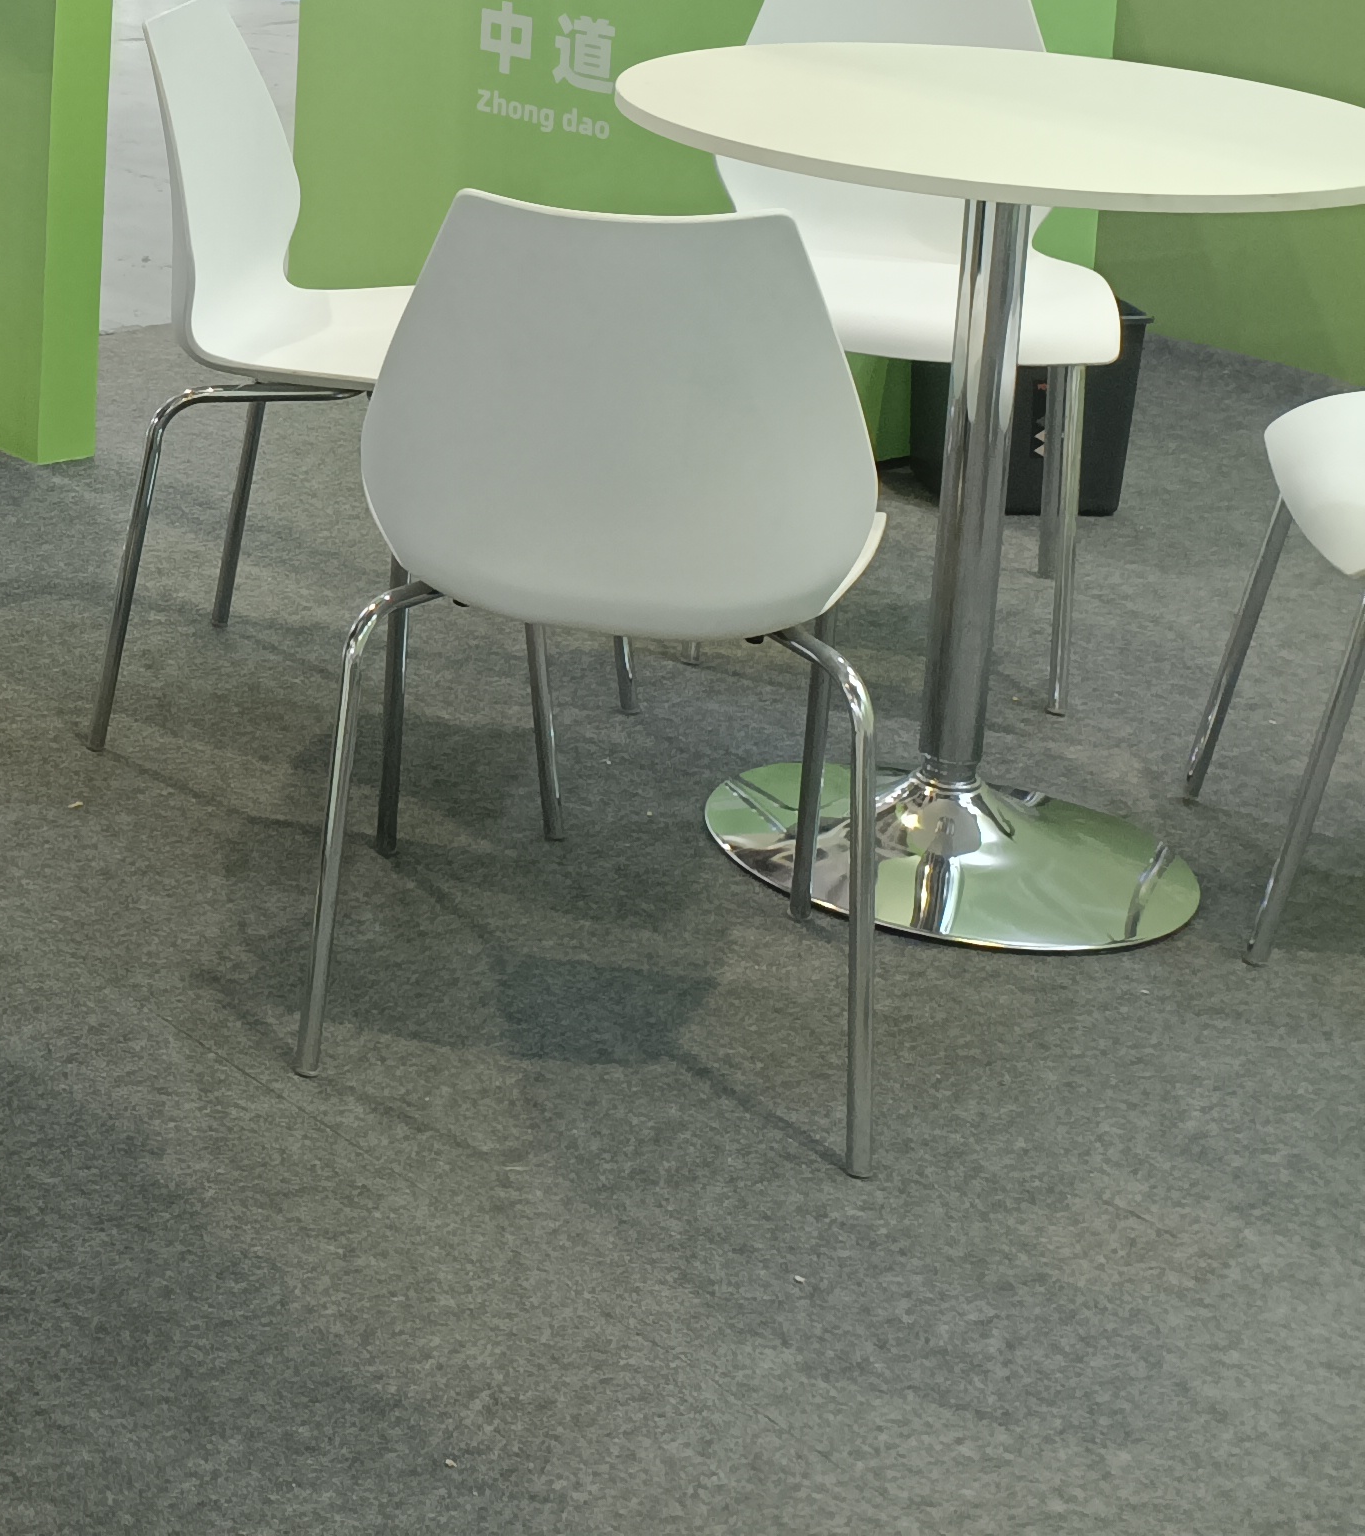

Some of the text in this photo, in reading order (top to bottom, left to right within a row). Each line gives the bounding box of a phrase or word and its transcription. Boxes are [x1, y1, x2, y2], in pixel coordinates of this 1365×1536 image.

[480, 0, 616, 95] 中道
[476, 88, 610, 140] Zhong dao
